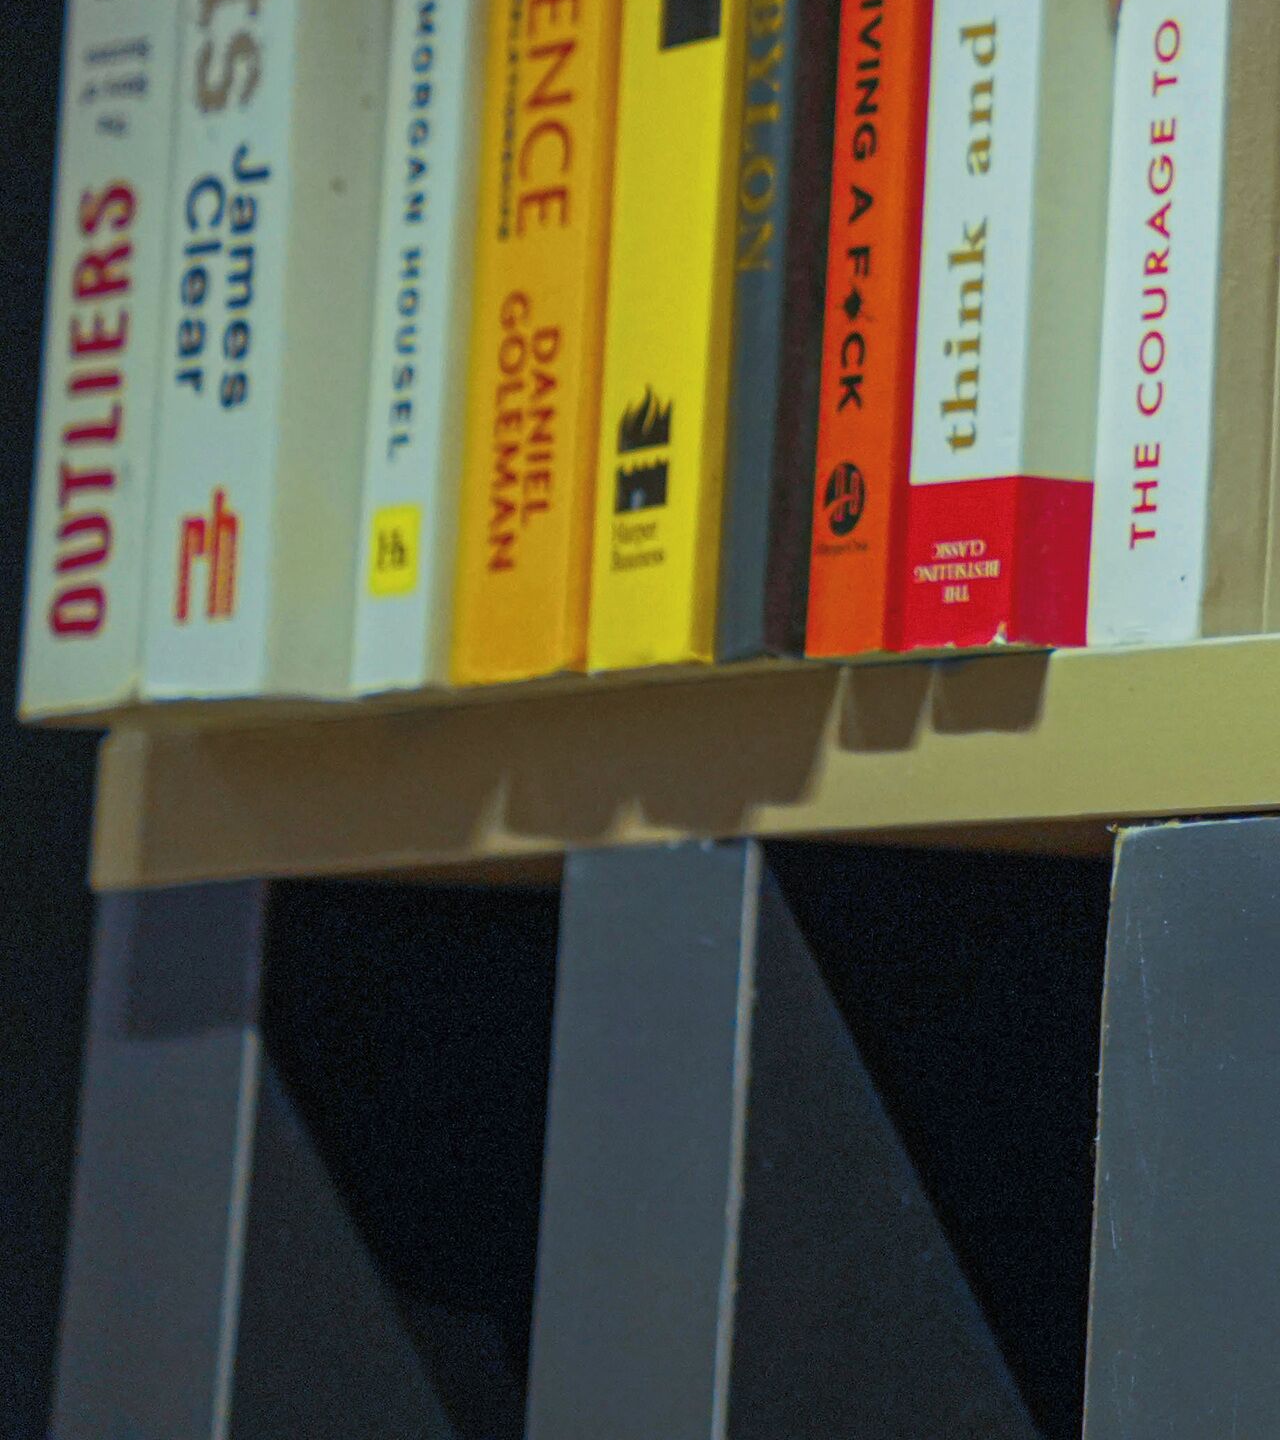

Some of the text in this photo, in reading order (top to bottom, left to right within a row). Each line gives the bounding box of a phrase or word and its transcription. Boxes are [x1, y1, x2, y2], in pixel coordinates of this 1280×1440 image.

[960, 19, 995, 175] and
[1152, 19, 1180, 96] TO
[175, 175, 225, 394] Clear
[220, 144, 271, 410] James
[385, 0, 438, 463] MORGAN HOUSEL
[847, 186, 872, 224] A
[1136, 117, 1177, 418] COURAGE
[46, 180, 137, 639] OUTLIERS
[486, 289, 531, 575] GOLEMAN
[516, 325, 565, 526] DANIEL
[940, 217, 987, 455] think
[913, 560, 1000, 583] BESTSELLING
[932, 539, 986, 559] CLASSIC
[942, 585, 969, 603] THE
[1129, 445, 1162, 550] THE
